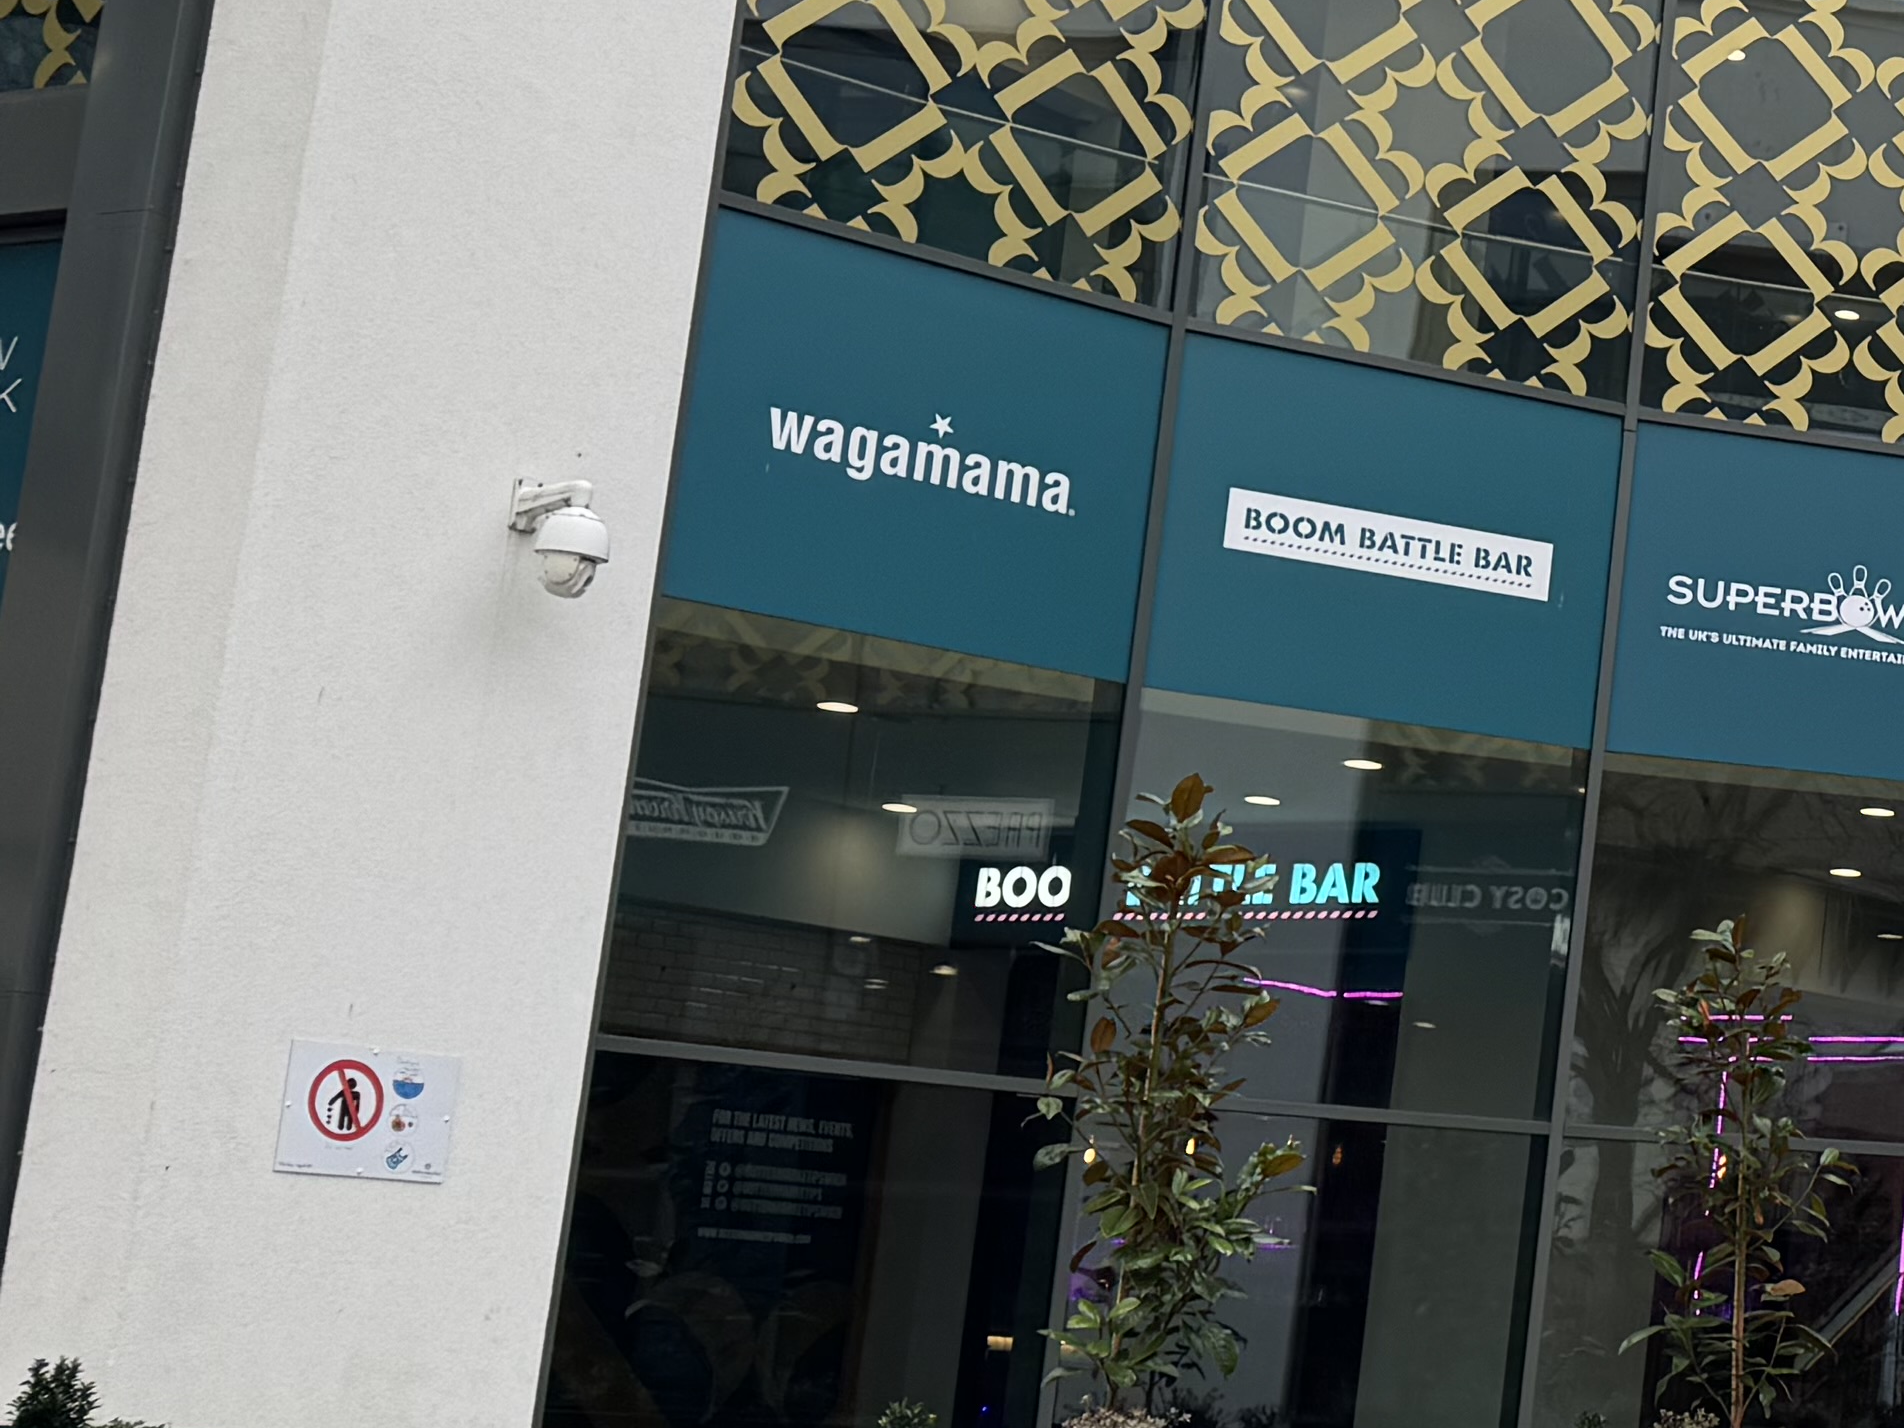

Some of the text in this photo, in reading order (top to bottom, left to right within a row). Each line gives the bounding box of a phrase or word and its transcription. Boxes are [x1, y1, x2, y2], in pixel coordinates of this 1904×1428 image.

[1244, 507, 1533, 578] BOOM BATTLE BAR
[1660, 625, 1686, 640] THE
[1688, 628, 1720, 644] UK'S
[1722, 633, 1787, 652] ULTIMATE
[1789, 640, 1839, 657] FAMILY
[974, 865, 1072, 909] BOO
[1288, 862, 1381, 906] BAR
